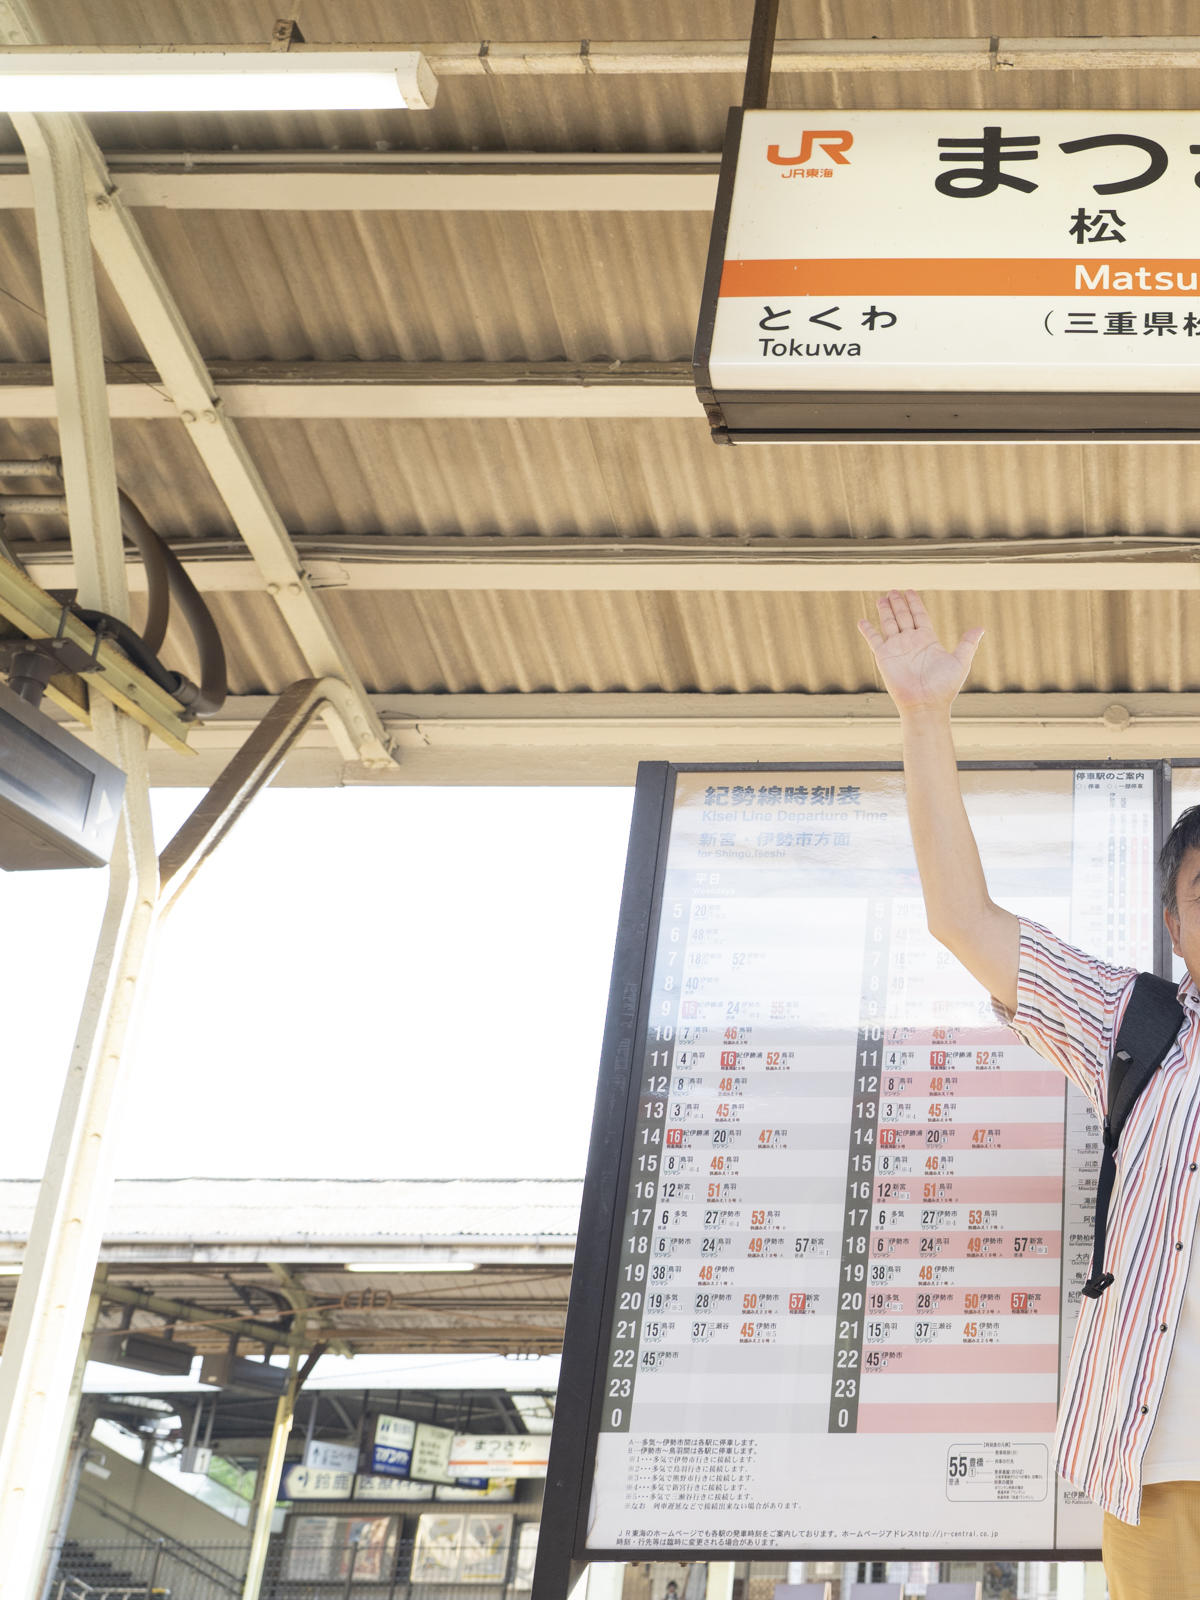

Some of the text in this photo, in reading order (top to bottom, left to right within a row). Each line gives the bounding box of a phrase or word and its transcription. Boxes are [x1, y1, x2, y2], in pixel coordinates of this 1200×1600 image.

[767, 130, 854, 165] JR
[781, 168, 833, 178] JR東海
[759, 304, 898, 332] とくわ
[759, 338, 862, 357] Tokuwa
[705, 786, 861, 806] 紀勢線時刻表
[702, 810, 888, 824] Kisei Line Departure Time
[673, 904, 682, 918] 5
[671, 928, 680, 942] 6
[668, 952, 677, 966] 7
[664, 976, 673, 991] 8
[661, 1001, 671, 1015] 9
[655, 1027, 672, 1041] 10
[683, 1028, 689, 1039] 7
[861, 1026, 880, 1041] 10
[651, 1052, 668, 1066] 11
[680, 1053, 686, 1064] 4
[723, 1053, 734, 1064] 16
[766, 1052, 779, 1065] 52
[860, 1052, 878, 1066] 11
[890, 1053, 896, 1064] 4
[932, 1053, 944, 1064] 16
[976, 1052, 989, 1065] 52
[648, 1077, 732, 1092] 12 8 48
[858, 1077, 943, 1092] 12 8 48
[645, 1103, 729, 1118] 13 3 45
[856, 1103, 941, 1118] 13 3 45
[642, 1129, 660, 1144] 14
[669, 1130, 681, 1143] 16
[714, 1131, 726, 1142] 20
[759, 1130, 772, 1143] 47
[854, 1129, 873, 1144] 14
[882, 1130, 894, 1143] 16
[927, 1131, 940, 1142] 20
[972, 1130, 986, 1143] 47
[638, 1156, 724, 1171] 15 8 46
[852, 1156, 939, 1171] 15 8 46
[635, 1183, 720, 1198] 16 12 51
[850, 1183, 936, 1198] 16 12 51
[632, 1210, 765, 1225] 17 6 27 53
[849, 1210, 982, 1225] 17 6 27 53
[628, 1237, 809, 1253] 18 6 24 49 57
[846, 1237, 1027, 1253] 18 6 24 49 57
[625, 1265, 713, 1281] 19 38 48
[844, 1265, 932, 1281] 19 38 48
[620, 1293, 805, 1309] 20 19 28 50 57
[841, 1293, 1026, 1310] 20 19 28 50 57
[617, 1321, 636, 1338] 21
[646, 1323, 659, 1336] 15
[693, 1323, 706, 1336] 37
[740, 1323, 754, 1337] 45
[840, 1322, 977, 1339] 21 15 37 45
[613, 1350, 634, 1368] 22
[642, 1352, 655, 1366] 45
[837, 1351, 880, 1368] 22 45
[609, 1379, 631, 1397] 23
[835, 1380, 856, 1397] 23
[611, 1409, 622, 1427] 0
[838, 1409, 849, 1427] 0
[949, 1457, 967, 1477] 55
